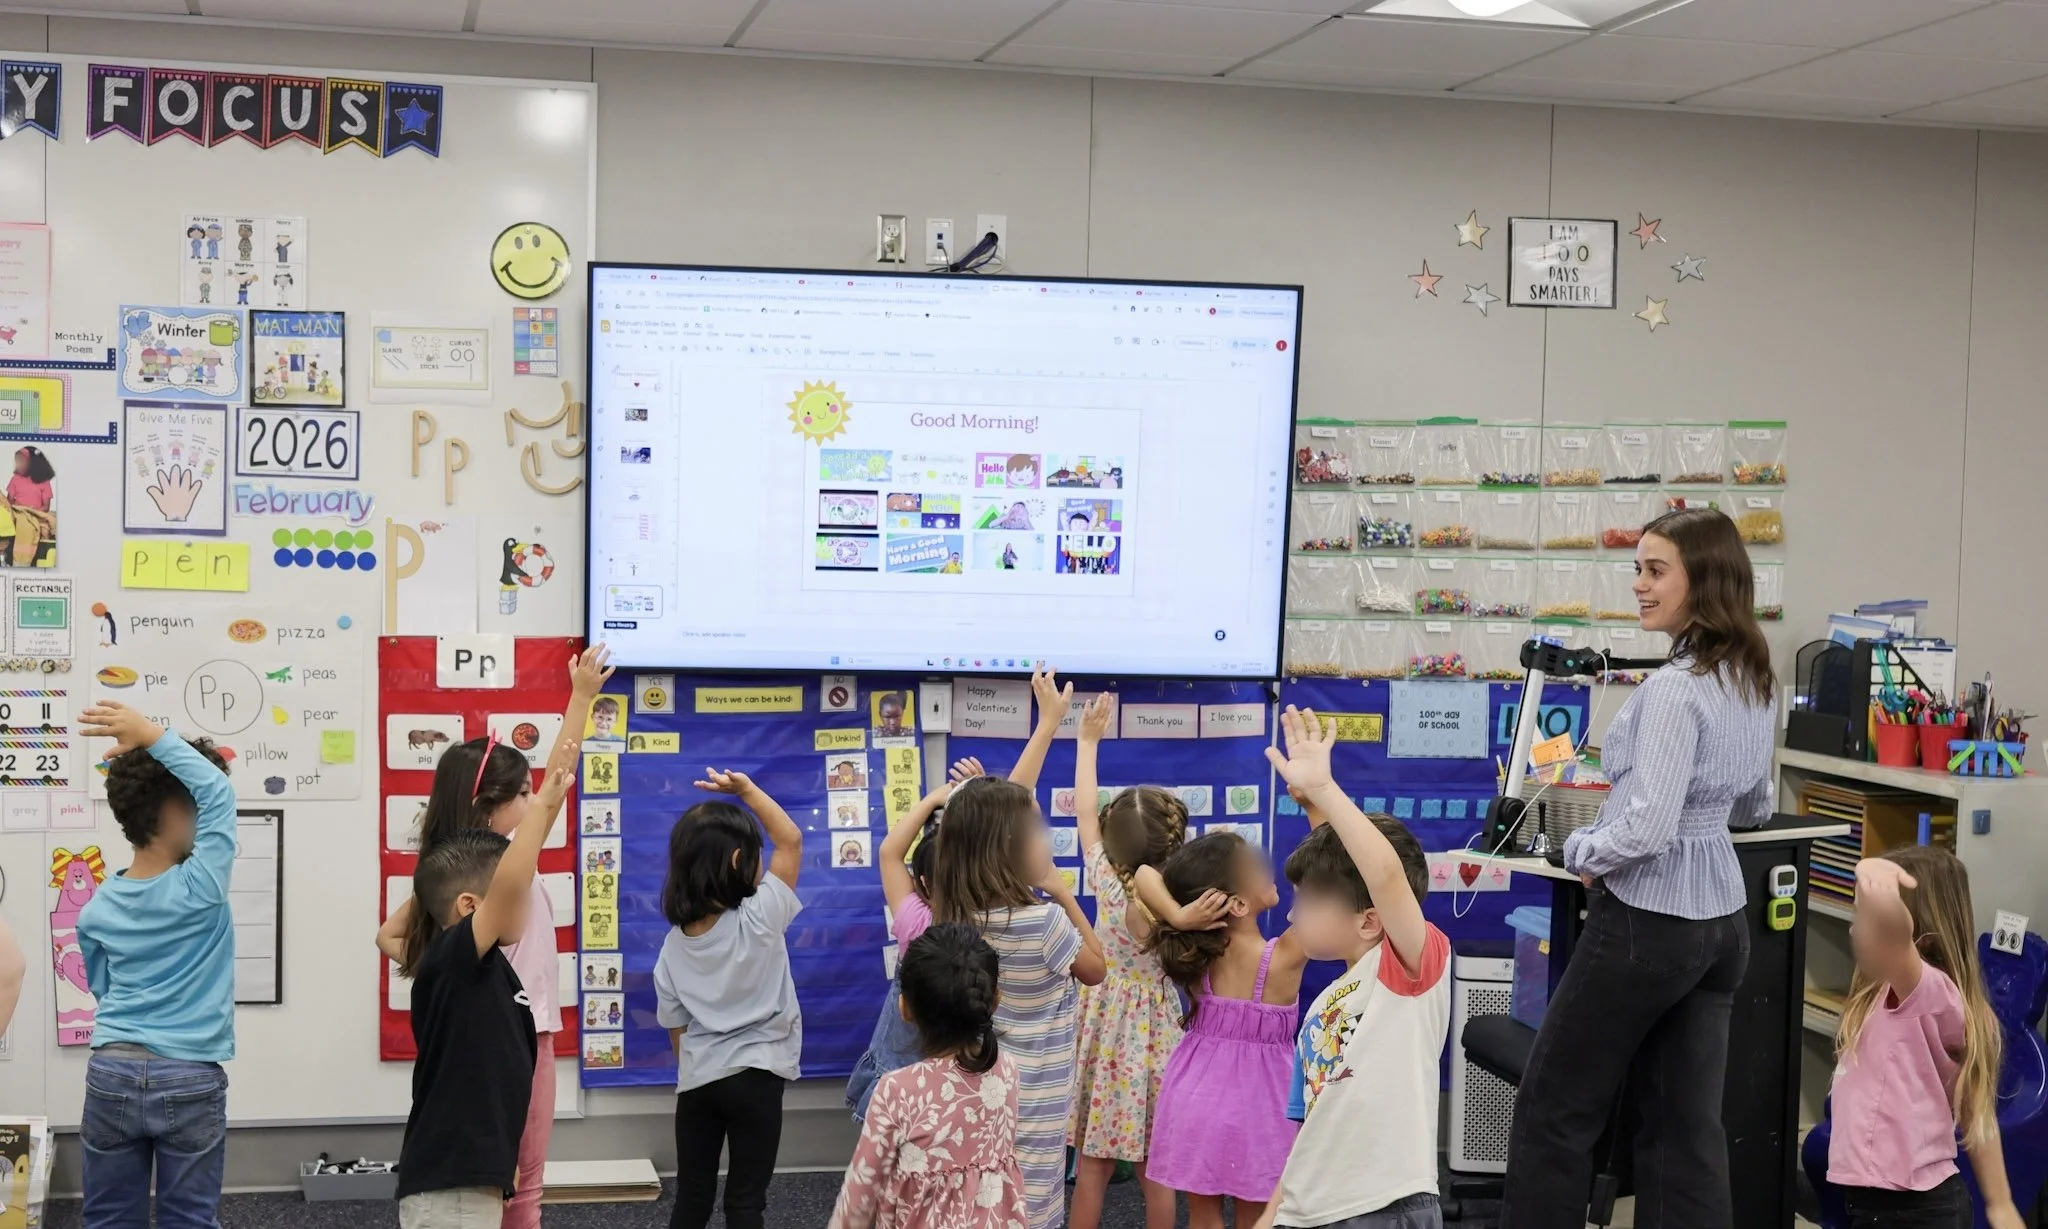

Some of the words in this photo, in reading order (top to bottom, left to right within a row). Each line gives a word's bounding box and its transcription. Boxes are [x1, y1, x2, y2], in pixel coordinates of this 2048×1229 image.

[13, 73, 46, 120] Y
[103, 78, 369, 137] FOCUS
[1549, 225, 1553, 240] I
[1559, 225, 1579, 241] AM
[1549, 266, 1579, 283] DAYS
[1529, 284, 1598, 303] SMARTER!
[55, 332, 104, 344] Monthly
[157, 322, 207, 338] Winter
[65, 345, 94, 355] Poem
[168, 413, 186, 425] Me
[910, 412, 956, 428] Good
[961, 413, 1039, 434] Morning!
[247, 417, 348, 470] 2026
[981, 463, 1005, 473] Hello
[233, 484, 373, 522] February
[916, 535, 945, 548] Good
[132, 550, 232, 577] pen
[888, 546, 949, 566] Morning
[15, 584, 70, 594] RECTANGLE
[130, 614, 194, 635] penguin
[277, 625, 326, 645] pizza
[144, 673, 169, 692] pie
[302, 667, 337, 687] peas
[967, 685, 997, 698] Happy
[705, 695, 728, 705] Ways
[966, 701, 1018, 714] Valentine's
[303, 709, 338, 727] pear
[965, 718, 986, 730] Day!
[1136, 715, 1165, 726] Thank
[1167, 718, 1183, 728] you
[1218, 712, 1236, 722] love
[1237, 714, 1253, 725] you
[1504, 705, 1572, 739] 10
[652, 738, 671, 746] Kind
[835, 734, 861, 743] Unkind
[36, 754, 60, 772] 23
[244, 742, 289, 768] pillow
[418, 755, 432, 765] pig
[295, 768, 321, 792] pot
[1239, 792, 1247, 806] B
[12, 805, 39, 817] gray
[60, 804, 85, 816] pink
[1334, 979, 1361, 1002] DAY
[74, 1029, 94, 1041] PIN
